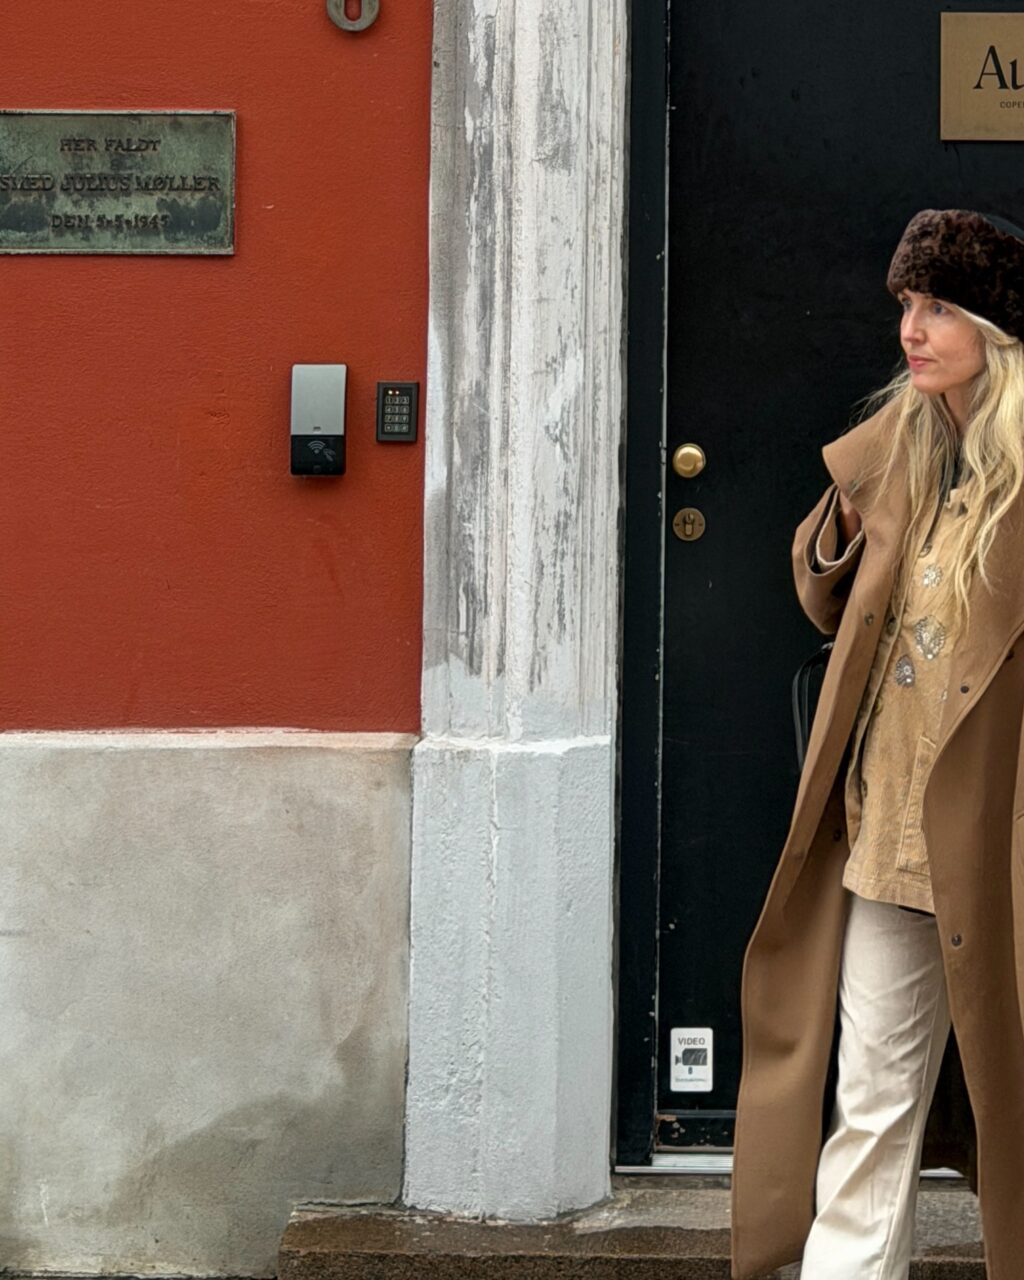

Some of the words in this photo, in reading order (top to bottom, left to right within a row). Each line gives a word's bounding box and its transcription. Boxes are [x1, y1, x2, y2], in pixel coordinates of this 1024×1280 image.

[60, 139, 97, 152] HER
[105, 138, 161, 152] FALDT
[60, 173, 131, 192] JULIUS
[135, 174, 221, 192] MØLLER
[51, 215, 89, 229] DEN
[678, 1037, 706, 1046] VIDEO
